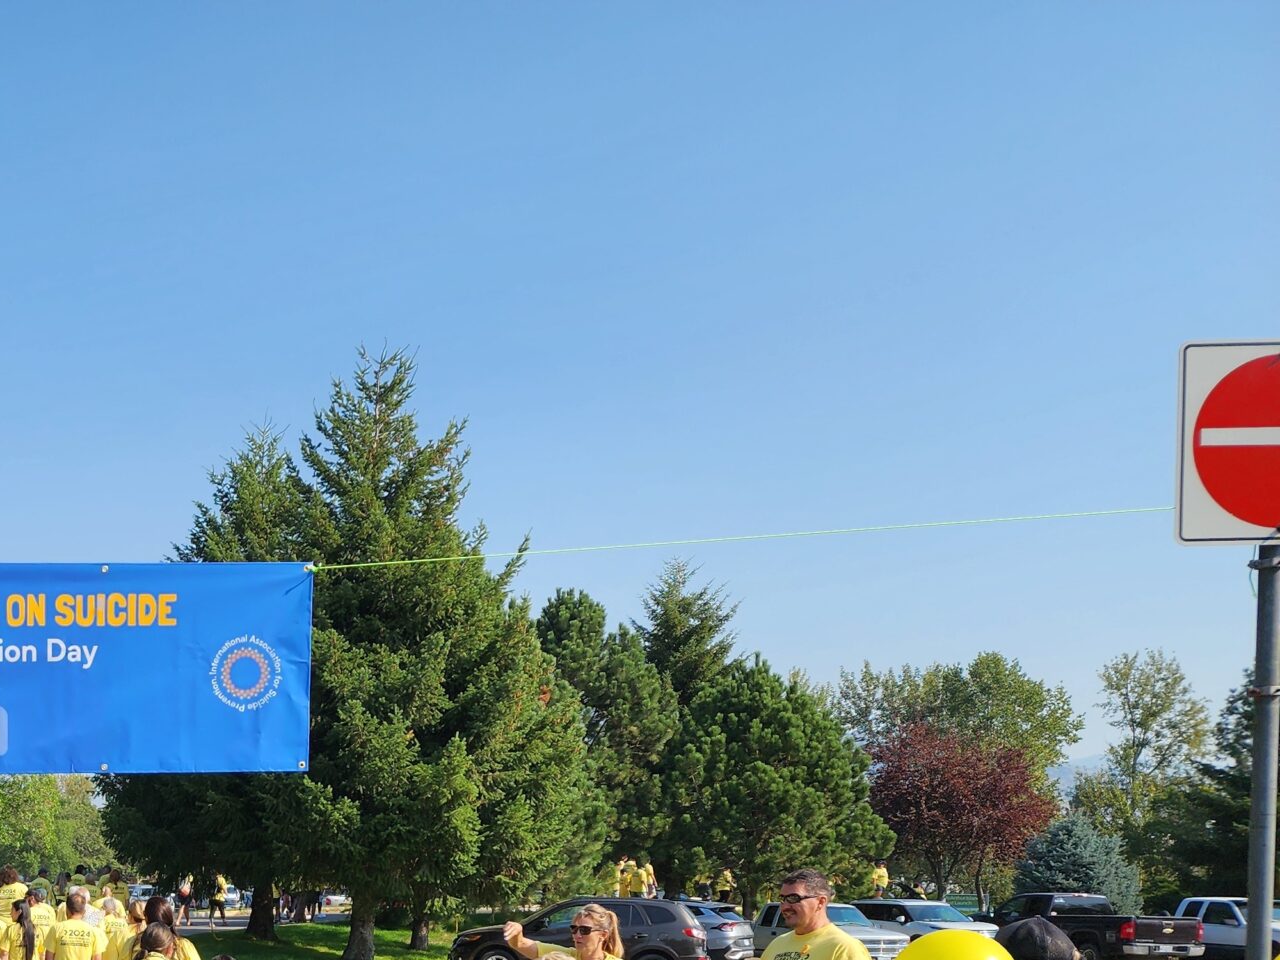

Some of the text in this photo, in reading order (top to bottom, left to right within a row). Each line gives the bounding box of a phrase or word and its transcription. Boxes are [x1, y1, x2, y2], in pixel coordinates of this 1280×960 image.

[6, 593, 46, 627] ON
[54, 593, 177, 627] SUICIDE
[46, 639, 98, 669] Day
[209, 634, 248, 675] International
[249, 634, 281, 674] Association
[273, 675, 283, 688] for
[247, 689, 277, 711] Suicide
